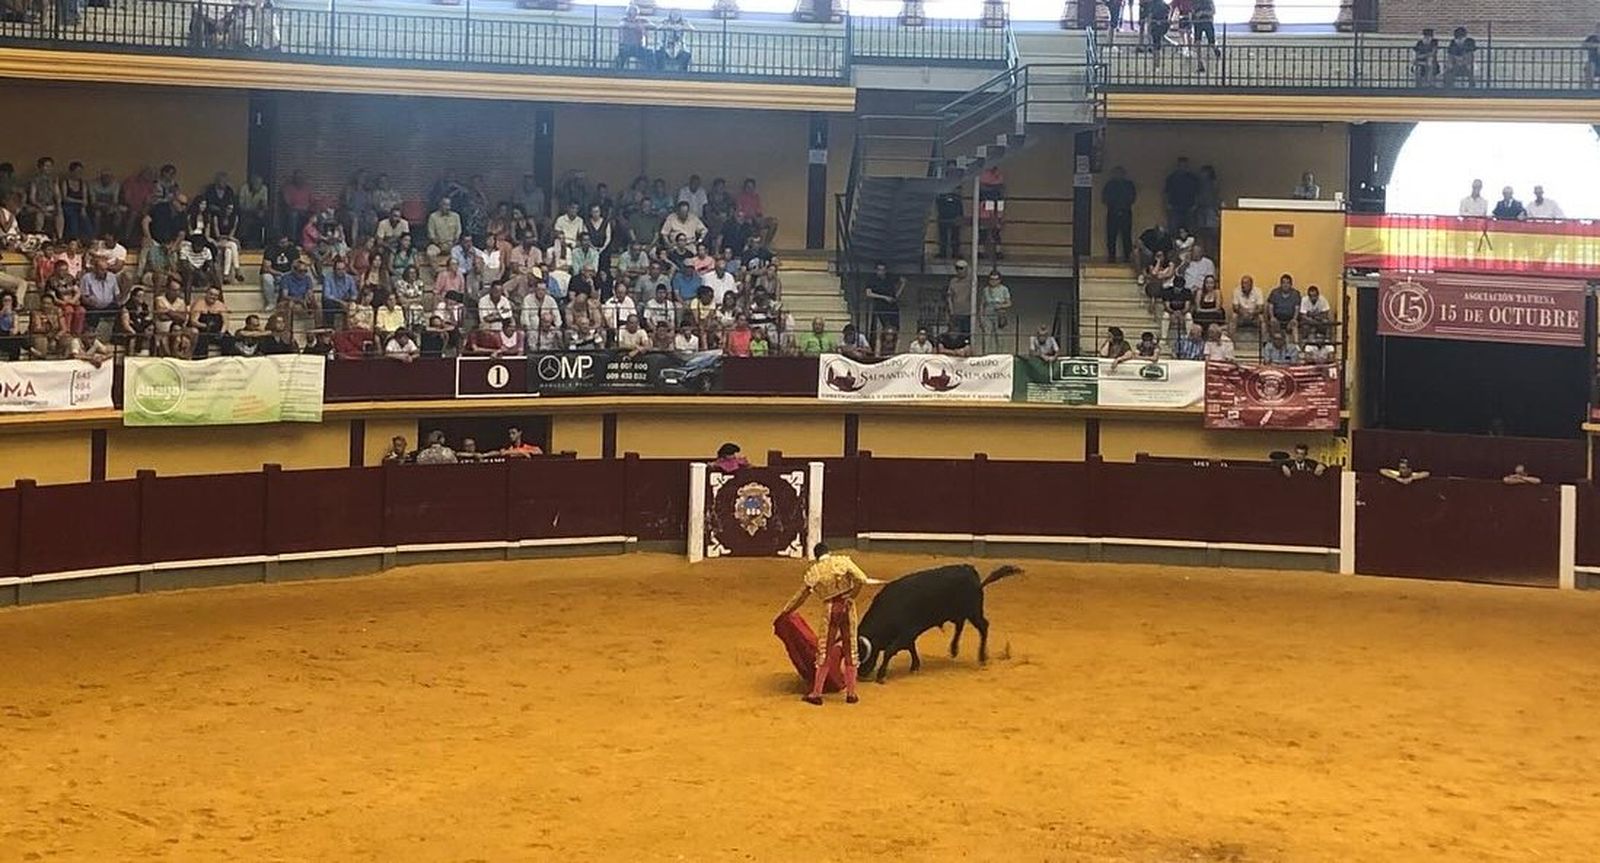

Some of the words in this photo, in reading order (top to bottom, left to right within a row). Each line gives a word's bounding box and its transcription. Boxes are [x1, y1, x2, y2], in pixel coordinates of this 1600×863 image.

[1398, 293, 1422, 321] 15
[1440, 304, 1457, 321] 15
[1464, 309, 1484, 322] DE
[1488, 306, 1579, 328] OCTUBRE
[561, 355, 593, 379] MP
[1072, 365, 1097, 376] est
